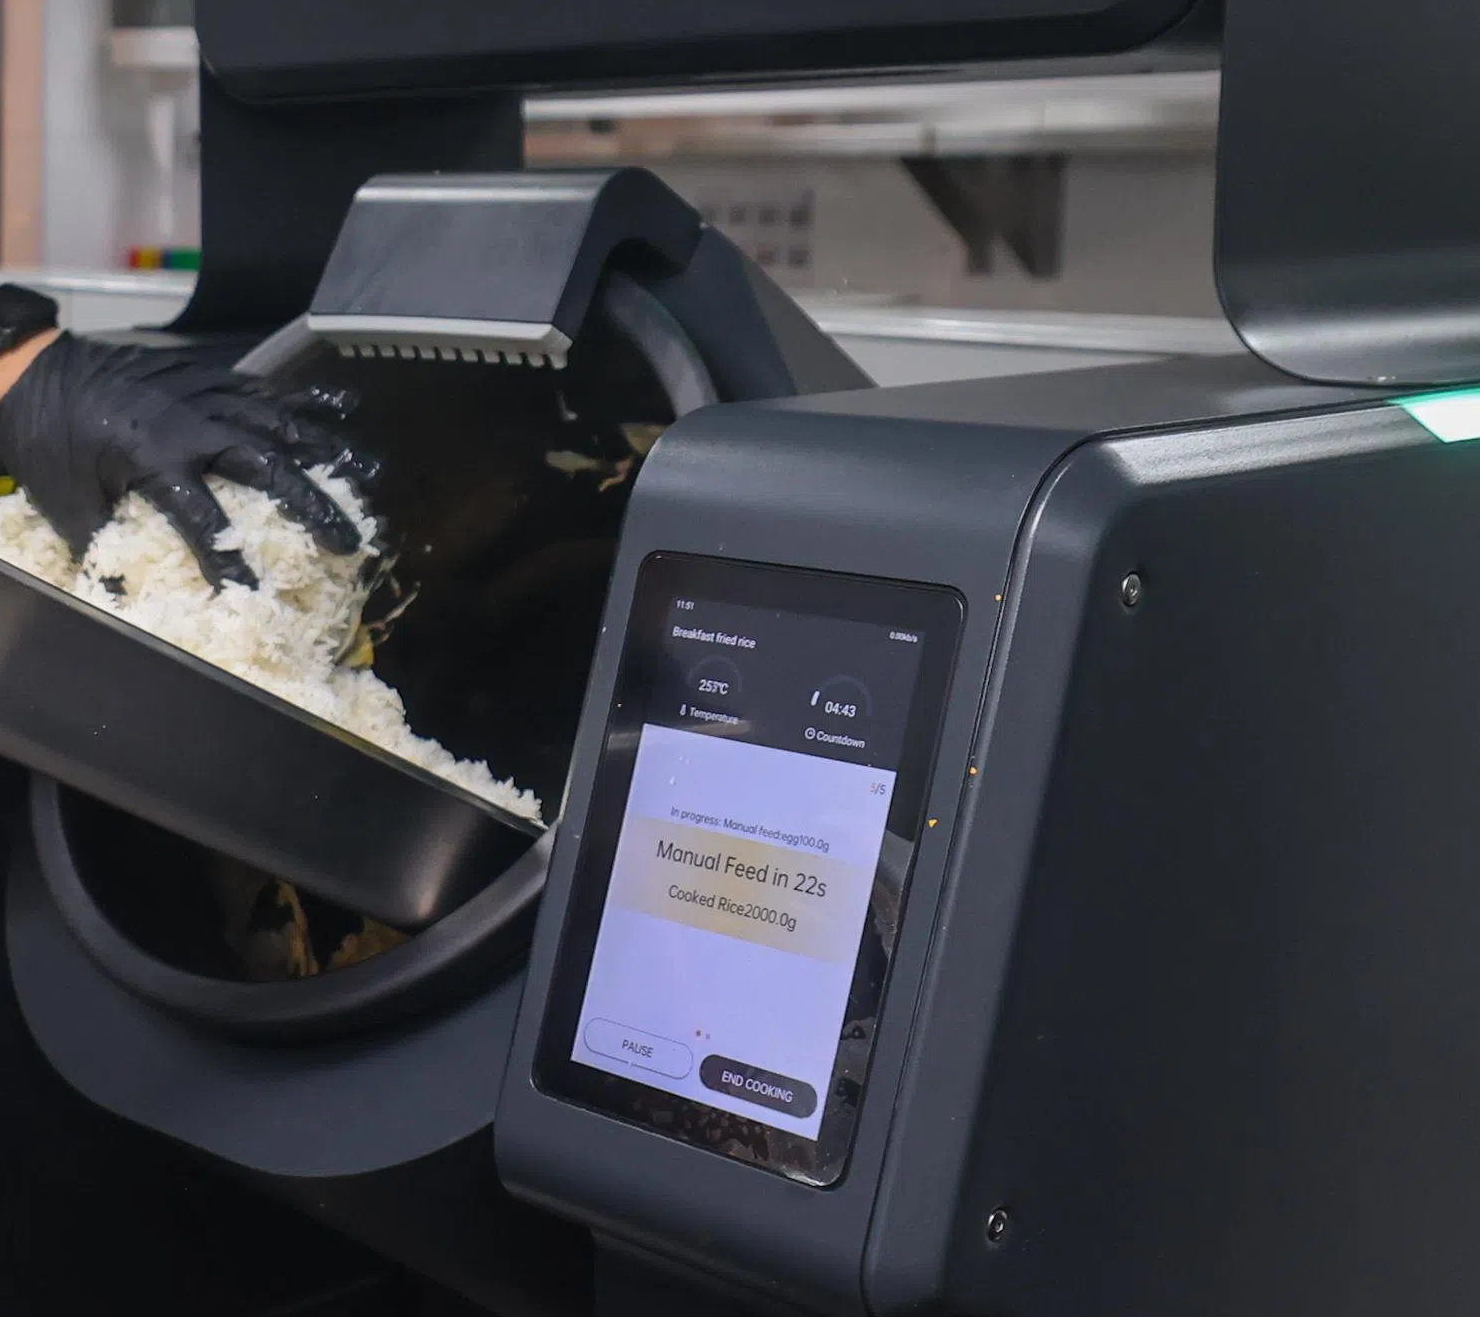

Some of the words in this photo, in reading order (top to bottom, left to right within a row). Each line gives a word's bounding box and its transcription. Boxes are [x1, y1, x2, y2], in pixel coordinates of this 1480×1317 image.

[672, 626, 715, 644] Breakfast
[716, 632, 737, 647] fried
[738, 636, 756, 649] rice
[689, 706, 739, 725] Temperature
[824, 701, 857, 718] 04:43
[816, 730, 866, 749] Countdown
[670, 805, 679, 817] In
[681, 808, 722, 826] progress:
[723, 818, 758, 835] Manual
[656, 840, 722, 872] Manual
[724, 856, 770, 884] Feed
[772, 867, 789, 888] in
[793, 872, 828, 898] 22s
[668, 884, 716, 909] Cooked
[621, 1038, 654, 1059] PAUSE
[721, 1069, 744, 1087] END
[745, 1078, 794, 1104] COOKING
